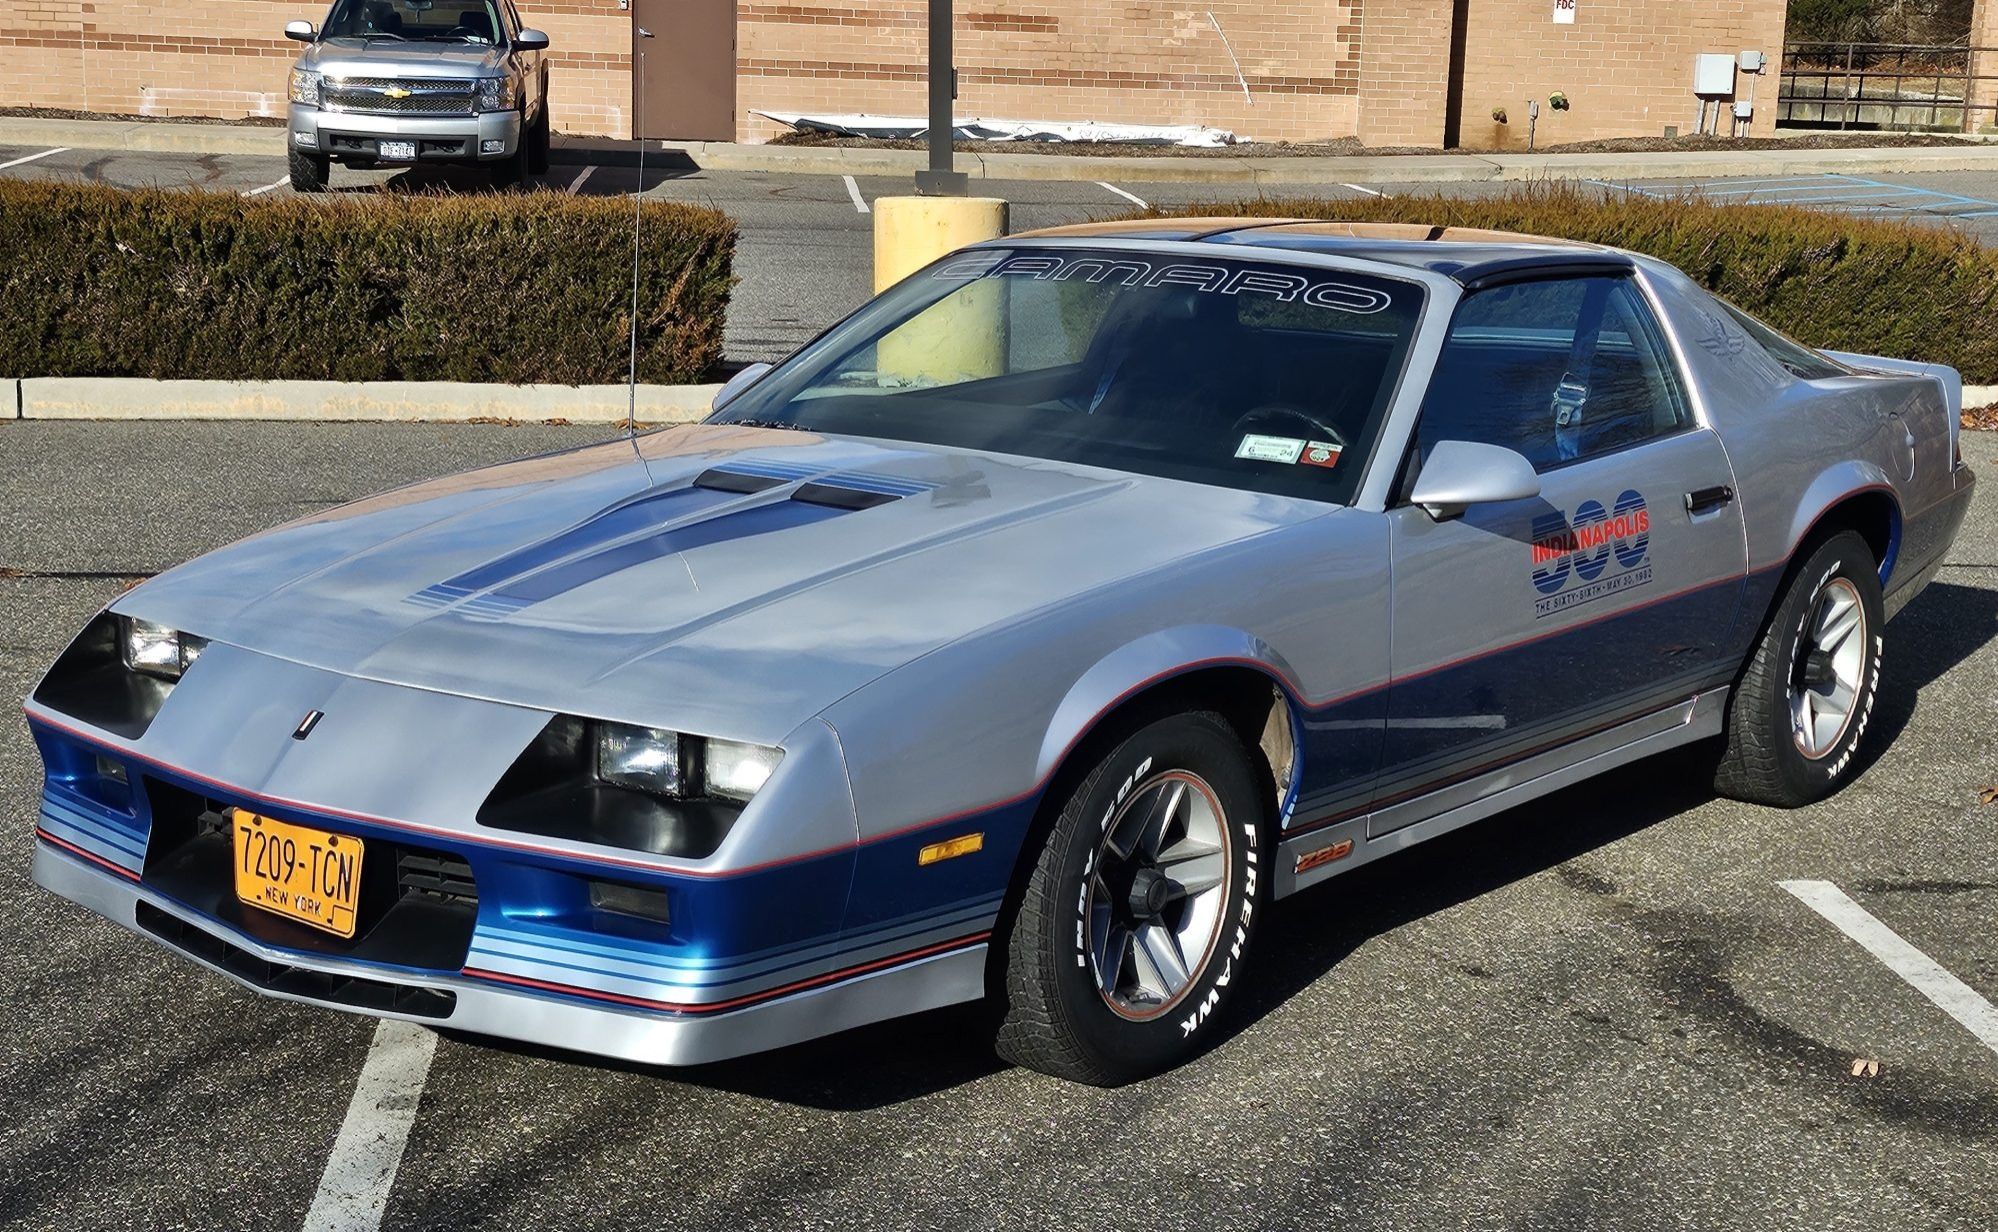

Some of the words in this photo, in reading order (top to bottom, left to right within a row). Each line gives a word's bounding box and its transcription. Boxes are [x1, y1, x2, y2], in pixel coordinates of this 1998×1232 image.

[1556, 0, 1575, 9] FDC
[931, 257, 1391, 314] CAMARO
[1531, 510, 1650, 565] INDIANAPOLIS
[1535, 601, 1550, 614] THE
[1606, 580, 1621, 591] MAY
[1827, 635, 1883, 780] FIREHAWK
[1101, 756, 1152, 832] 500
[240, 826, 353, 903] 7209-TCN
[265, 886, 289, 906] NEW
[295, 895, 321, 917] YORK
[1180, 823, 1258, 1039] FIREHAWK
